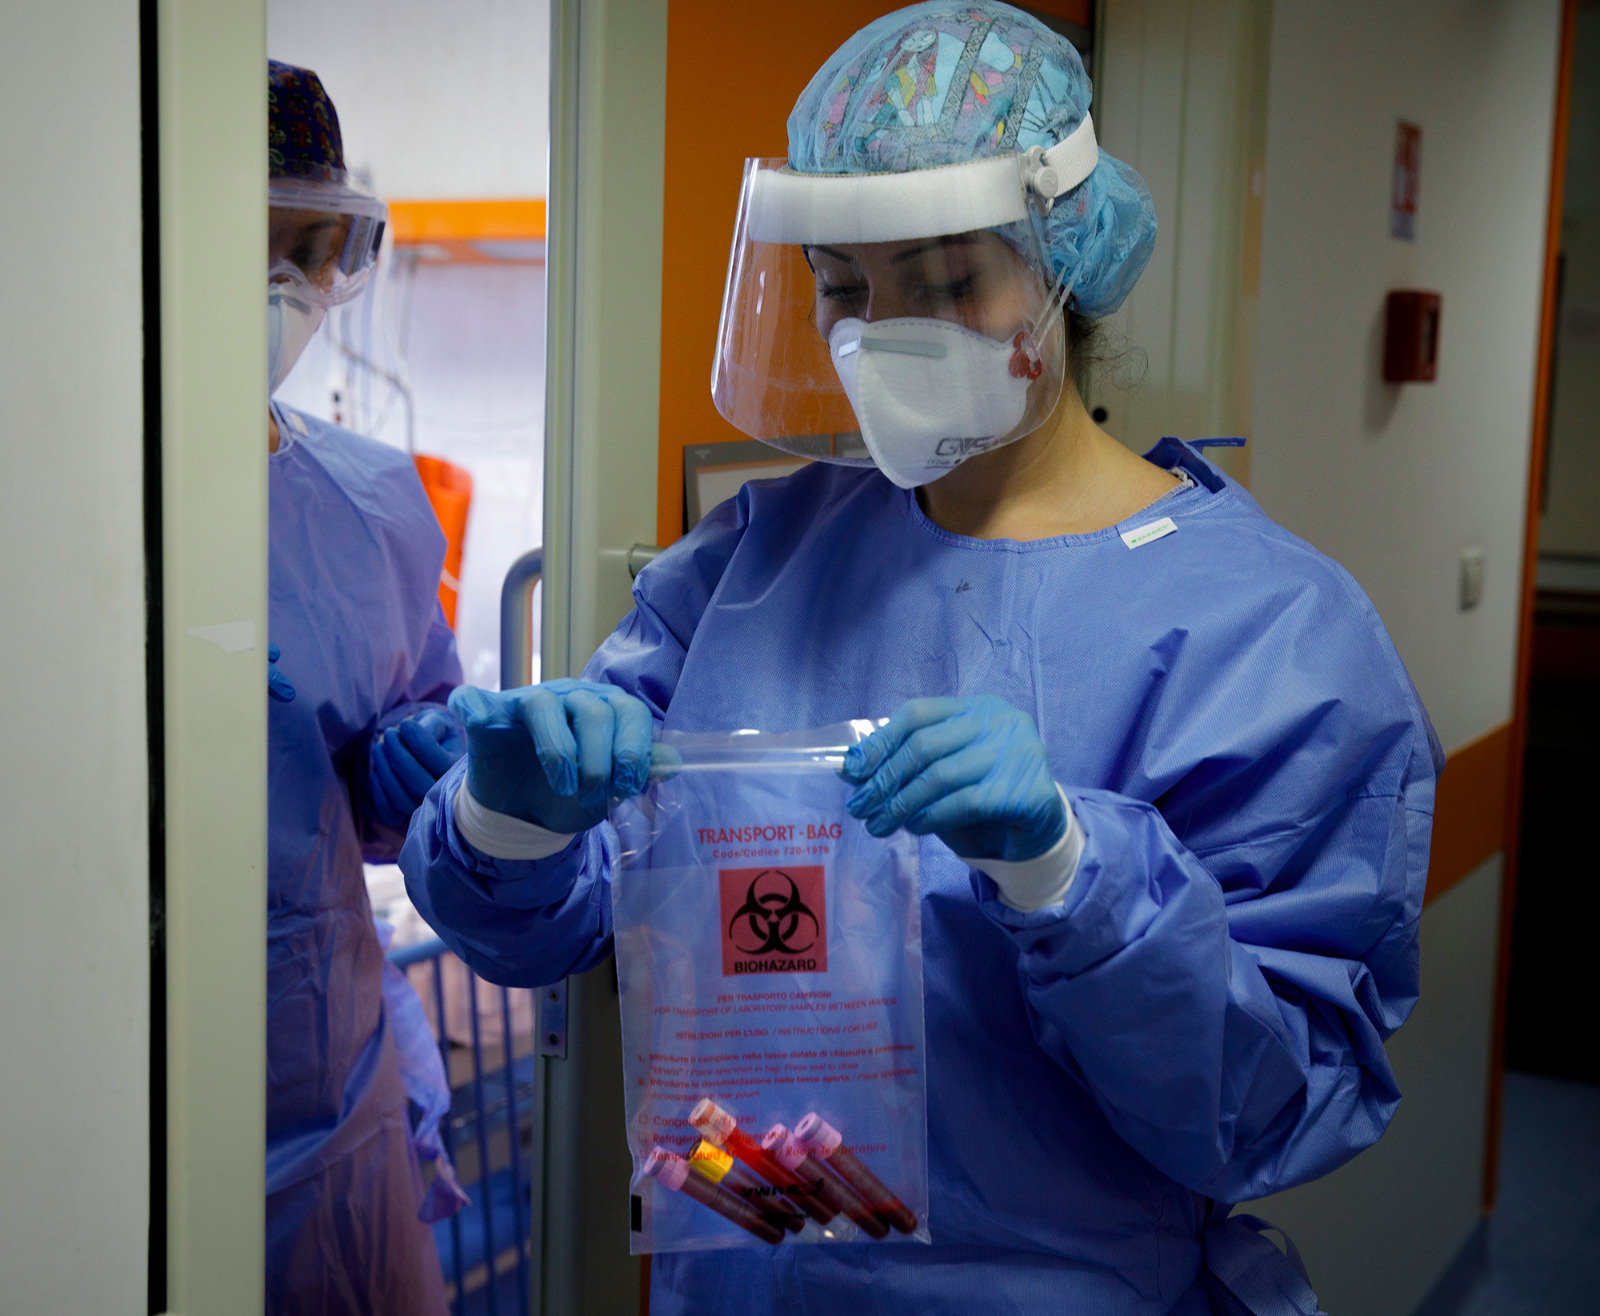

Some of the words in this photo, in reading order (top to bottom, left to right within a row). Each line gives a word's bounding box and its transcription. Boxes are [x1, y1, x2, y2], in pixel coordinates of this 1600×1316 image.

[935, 434, 995, 456] GVS
[697, 825, 794, 844] TRANSPORT
[806, 823, 842, 840] BAG
[712, 847, 779, 859] Code/Codice
[734, 958, 817, 974] BIOHAZARD
[717, 994, 735, 1003] PER
[736, 992, 787, 1002] TRASPORTO
[789, 990, 832, 1001] CAMPIONI
[733, 1003, 787, 1014] LABORATORY
[789, 1002, 826, 1012] SAMPLES
[828, 999, 867, 1010] BETWEEN
[675, 1031, 722, 1041] ISTRUZIONI
[724, 1028, 741, 1038] PER
[743, 1027, 769, 1037] L'USO
[777, 1024, 841, 1036] INSTRUCTIONS
[842, 1024, 860, 1034] FOR
[862, 1021, 879, 1031] USE
[698, 1053, 739, 1064] campione
